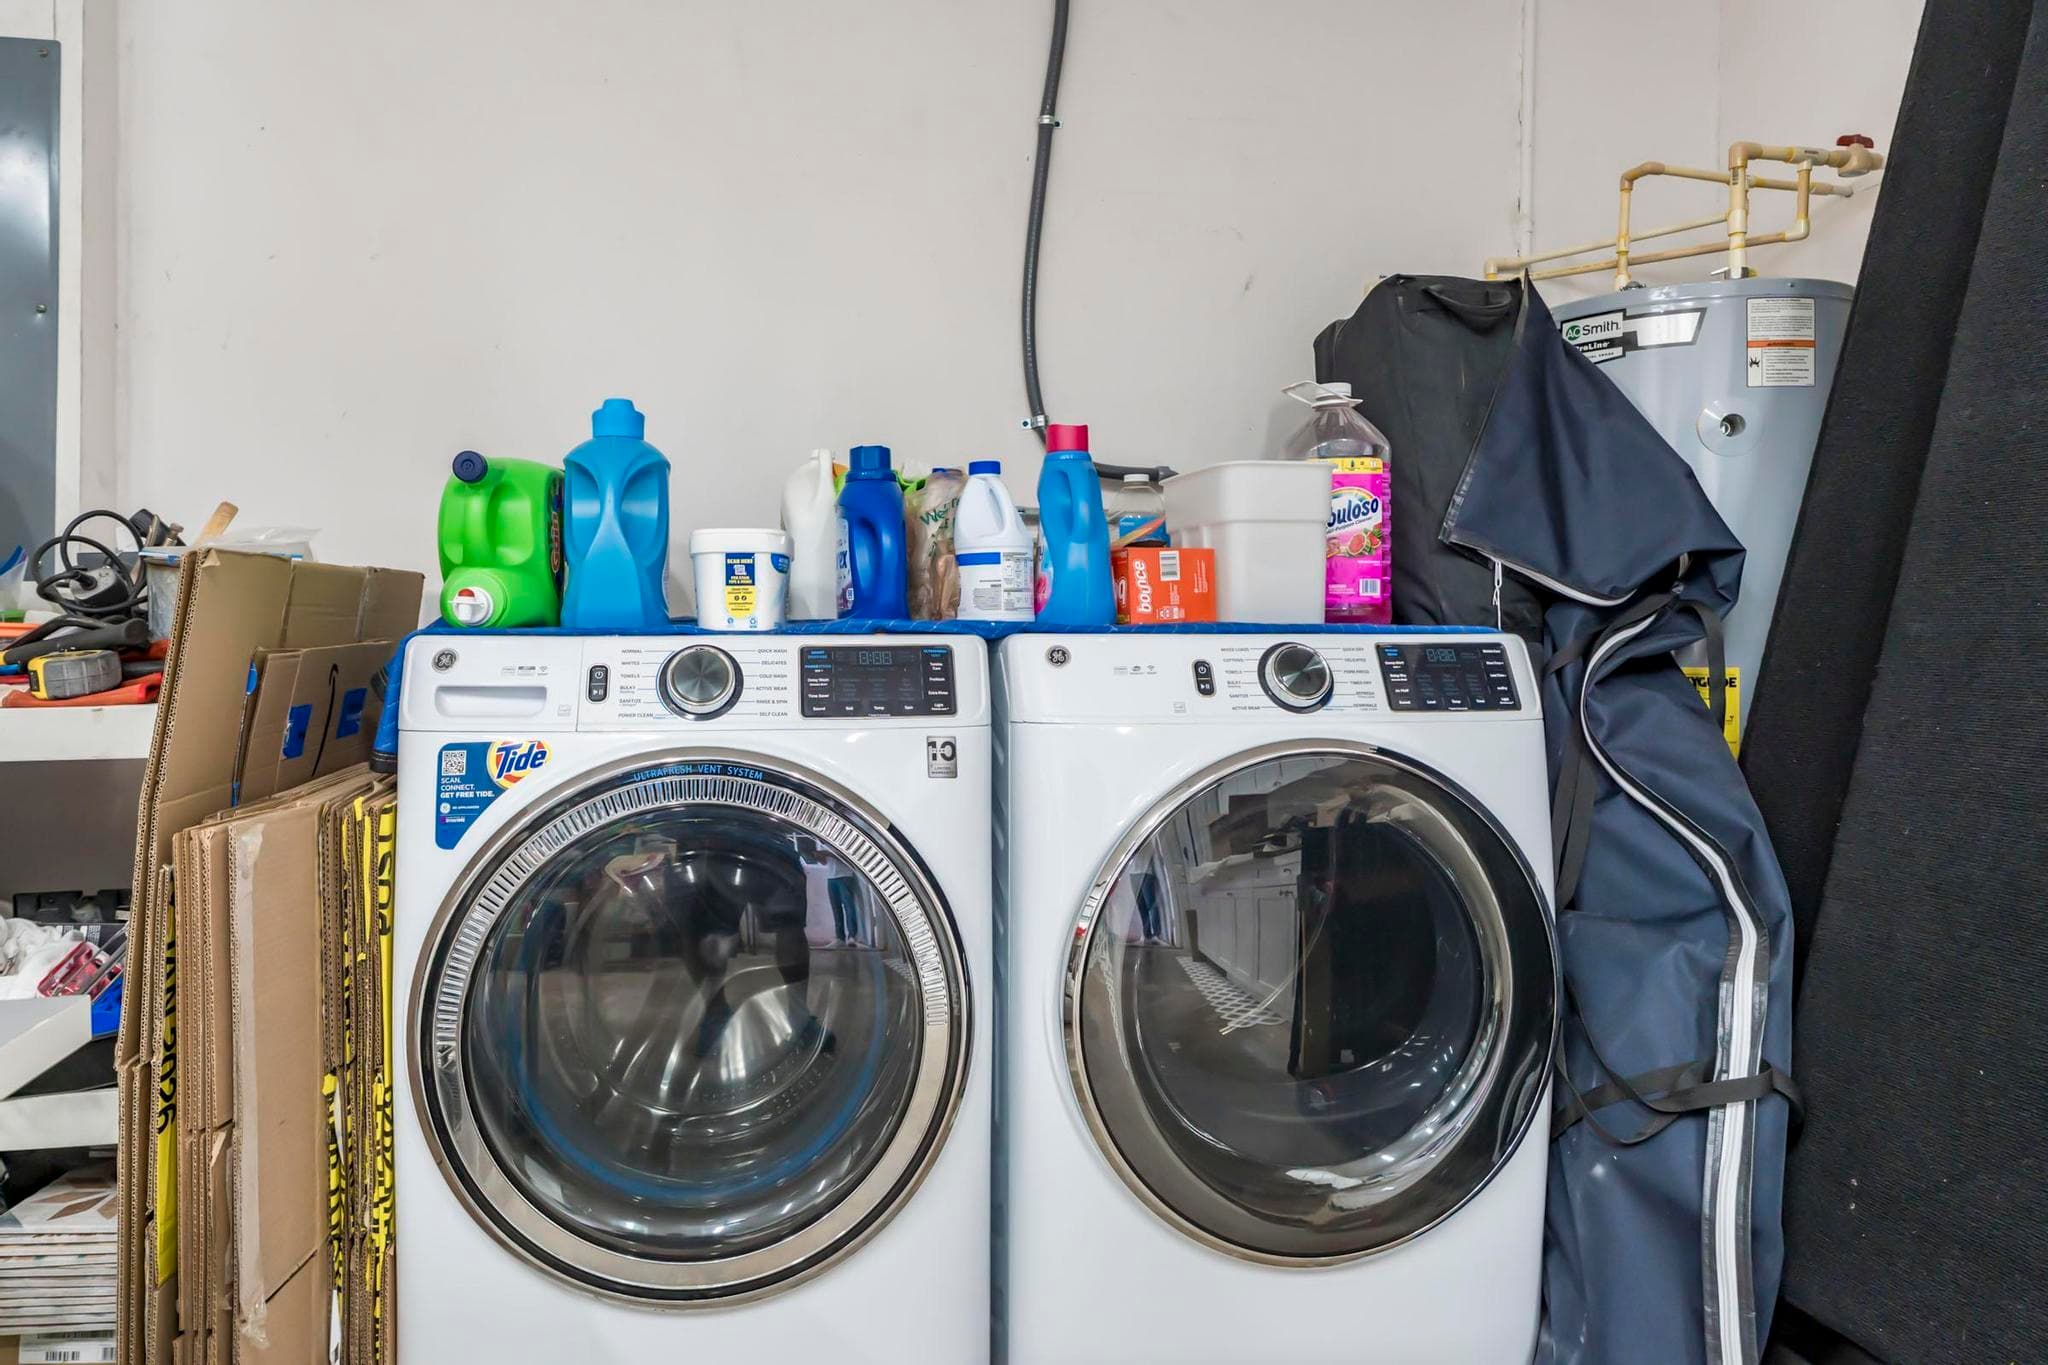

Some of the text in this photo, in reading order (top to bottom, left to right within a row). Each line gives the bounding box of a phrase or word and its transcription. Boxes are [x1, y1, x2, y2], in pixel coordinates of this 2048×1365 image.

[1583, 320, 1619, 335] Smith
[1134, 560, 1152, 614] bounce
[496, 742, 547, 779] Tide
[633, 764, 763, 782] ULTRAFRESH VENT SYSTEM
